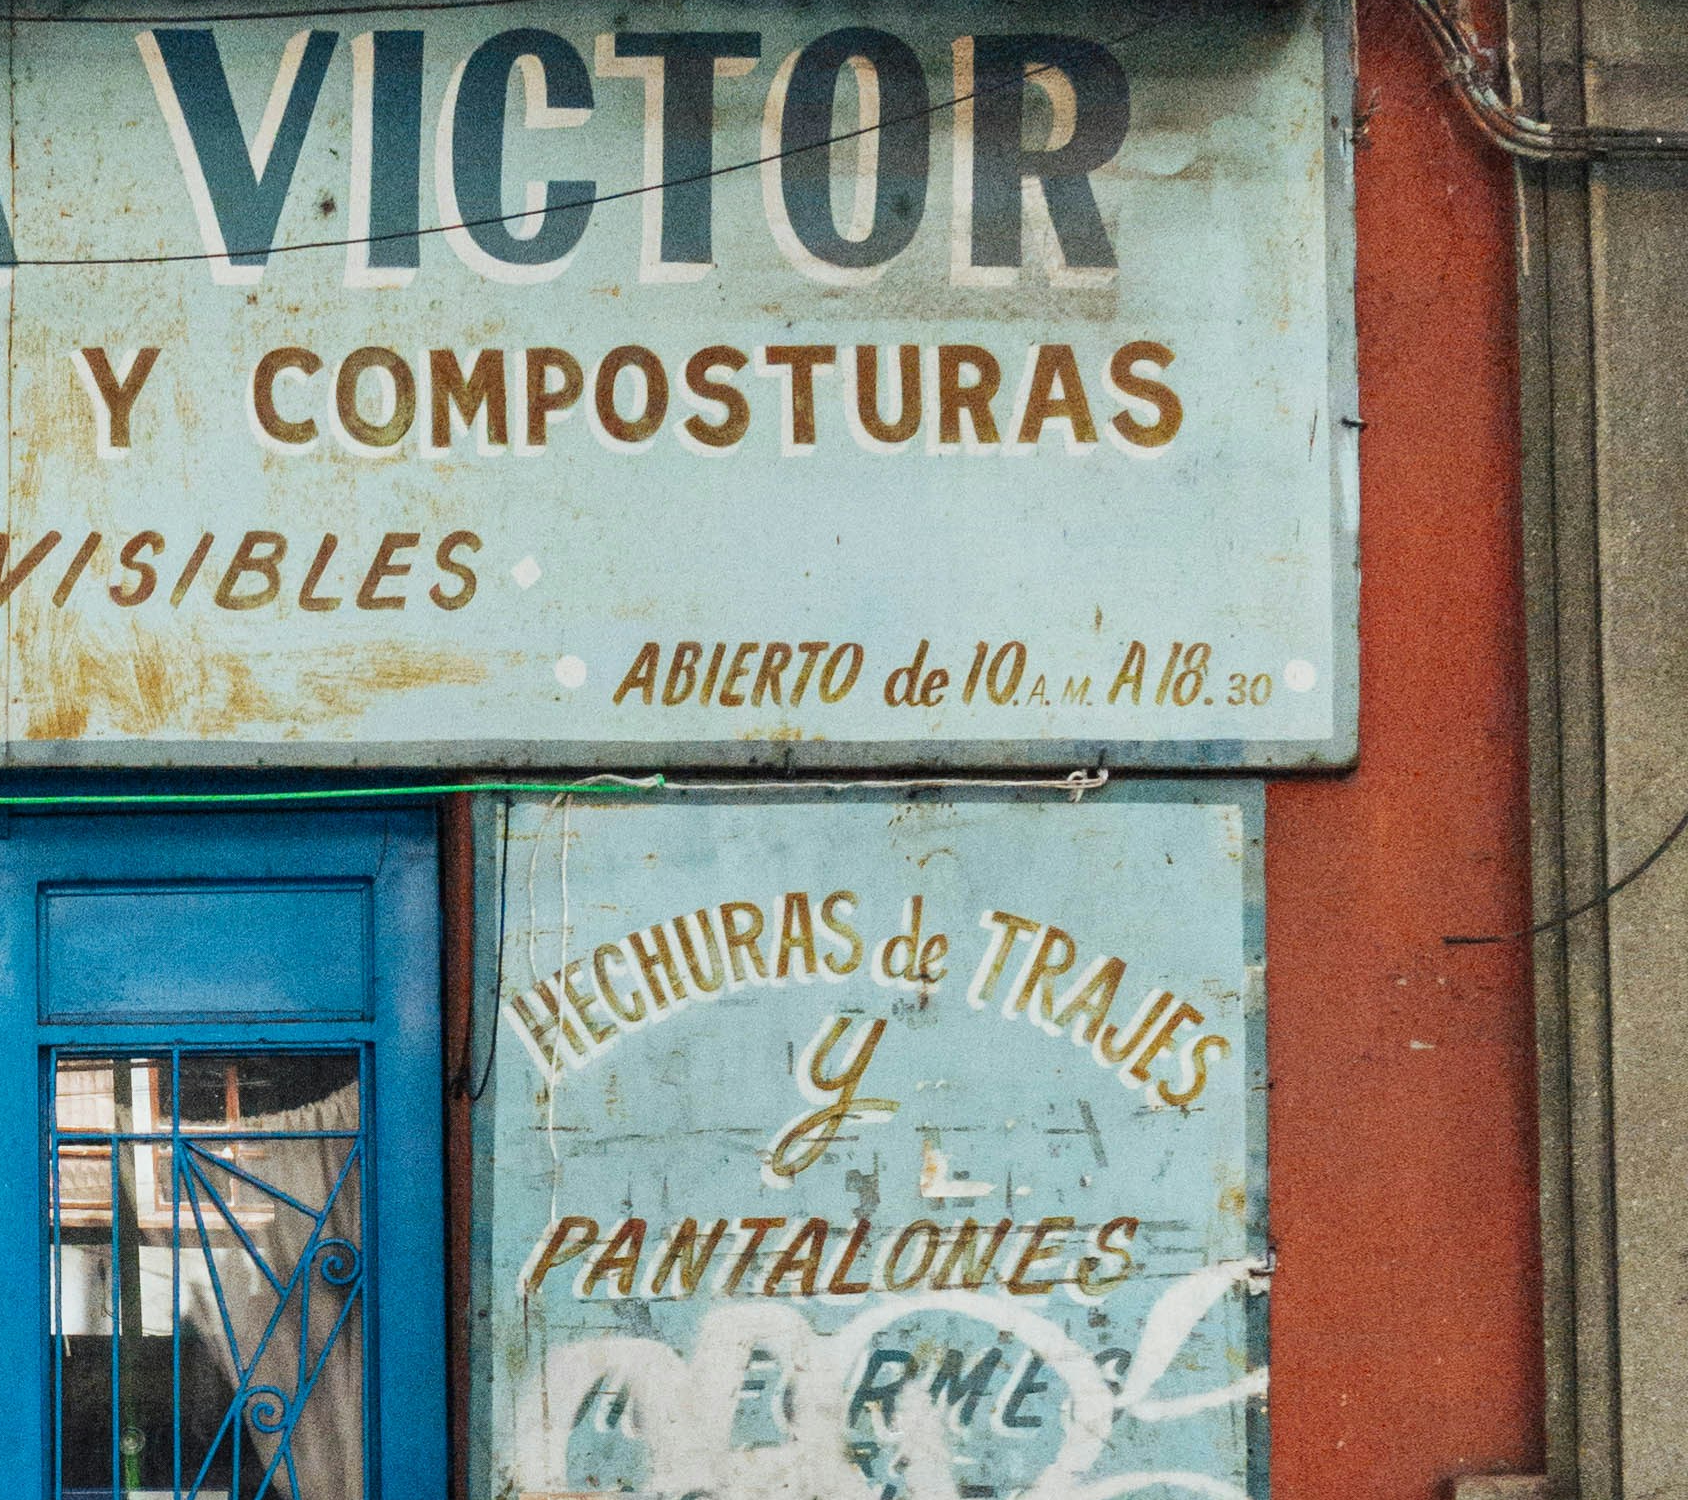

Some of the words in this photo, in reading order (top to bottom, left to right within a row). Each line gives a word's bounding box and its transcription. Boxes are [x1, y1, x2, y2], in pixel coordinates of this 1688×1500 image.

[140, 26, 1130, 288] VICTOR
[80, 345, 162, 449] Y
[251, 340, 1185, 449] COMPOSTURAS
[611, 640, 865, 708] ABIERTO
[882, 639, 950, 707] de
[1107, 640, 1149, 707] A
[514, 889, 864, 1074] HECHURAS
[881, 894, 950, 986] de
[982, 909, 1233, 1107] TRAJES
[531, 1215, 1140, 1297] PANTALONES
